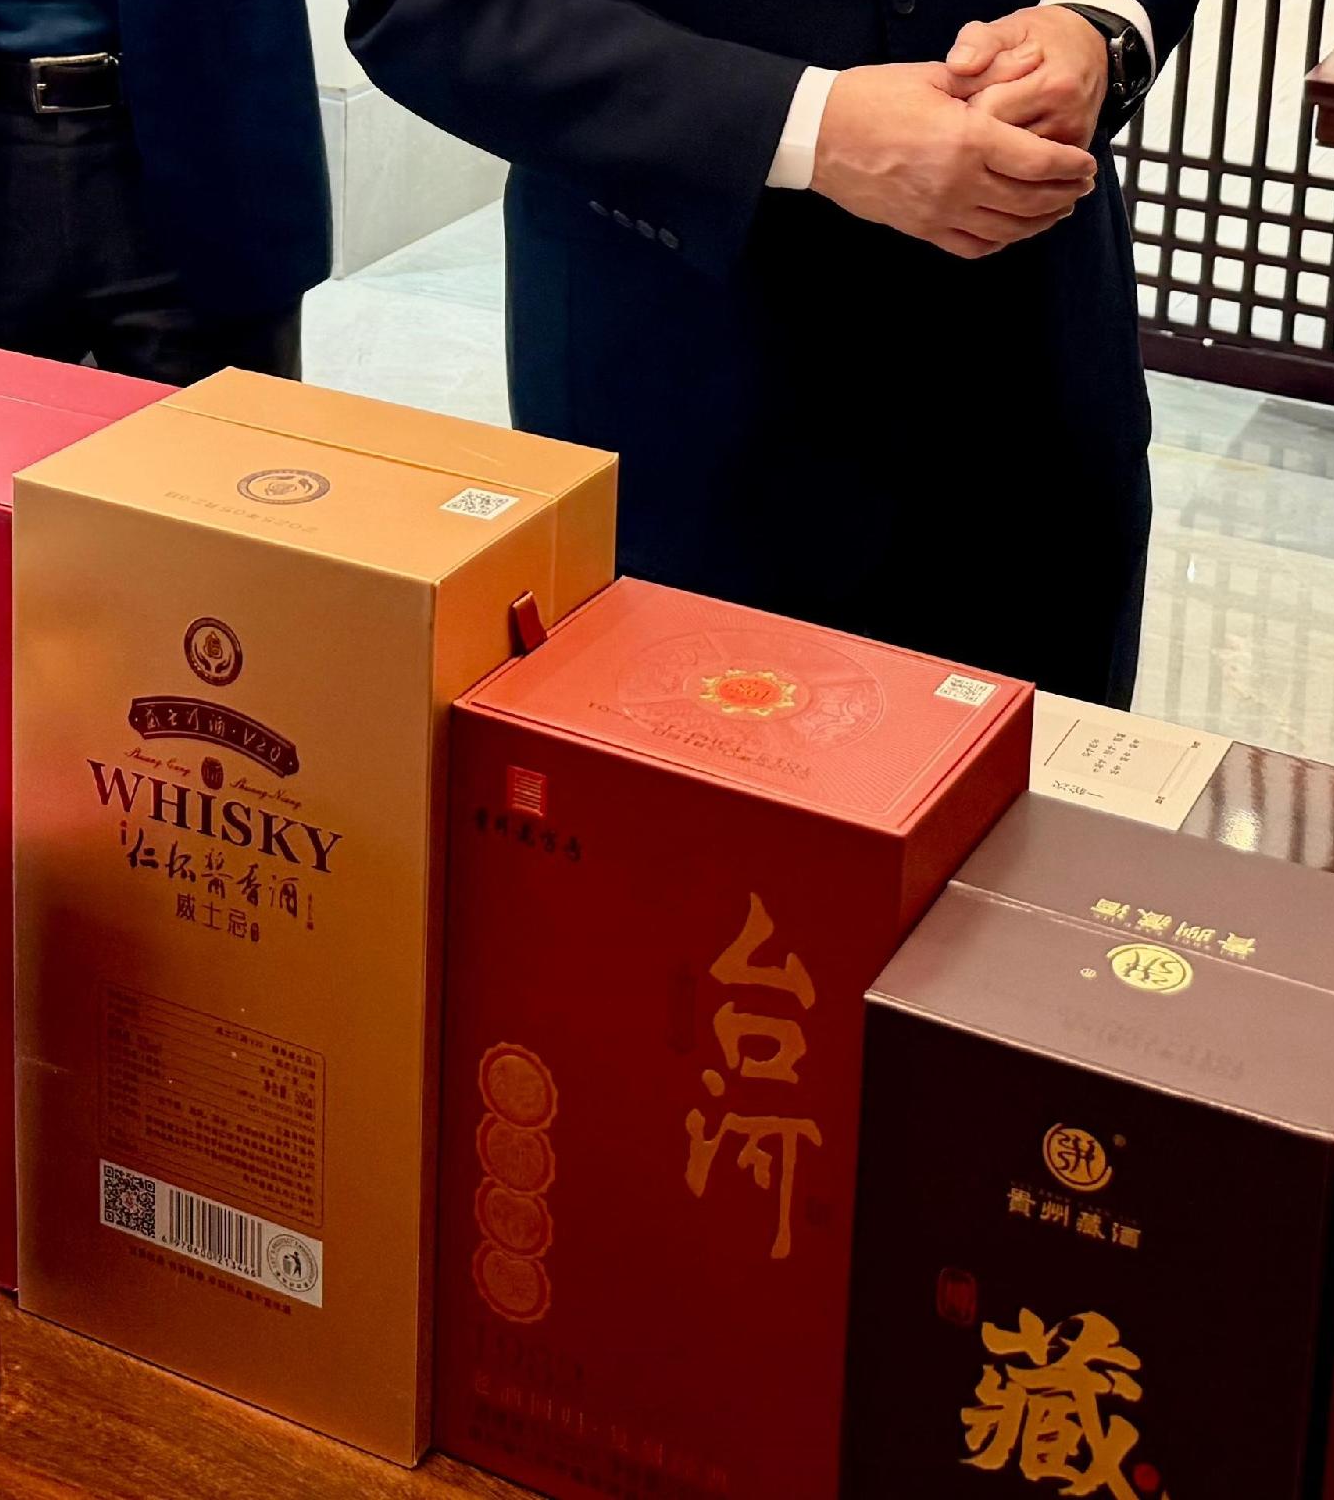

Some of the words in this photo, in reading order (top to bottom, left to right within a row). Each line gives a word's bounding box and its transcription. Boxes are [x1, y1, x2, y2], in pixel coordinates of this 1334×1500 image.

[86, 758, 343, 873] WHISKY
[175, 892, 247, 939] 威士忌
[685, 892, 822, 1260] 台河
[960, 1307, 1144, 1500] 藏
